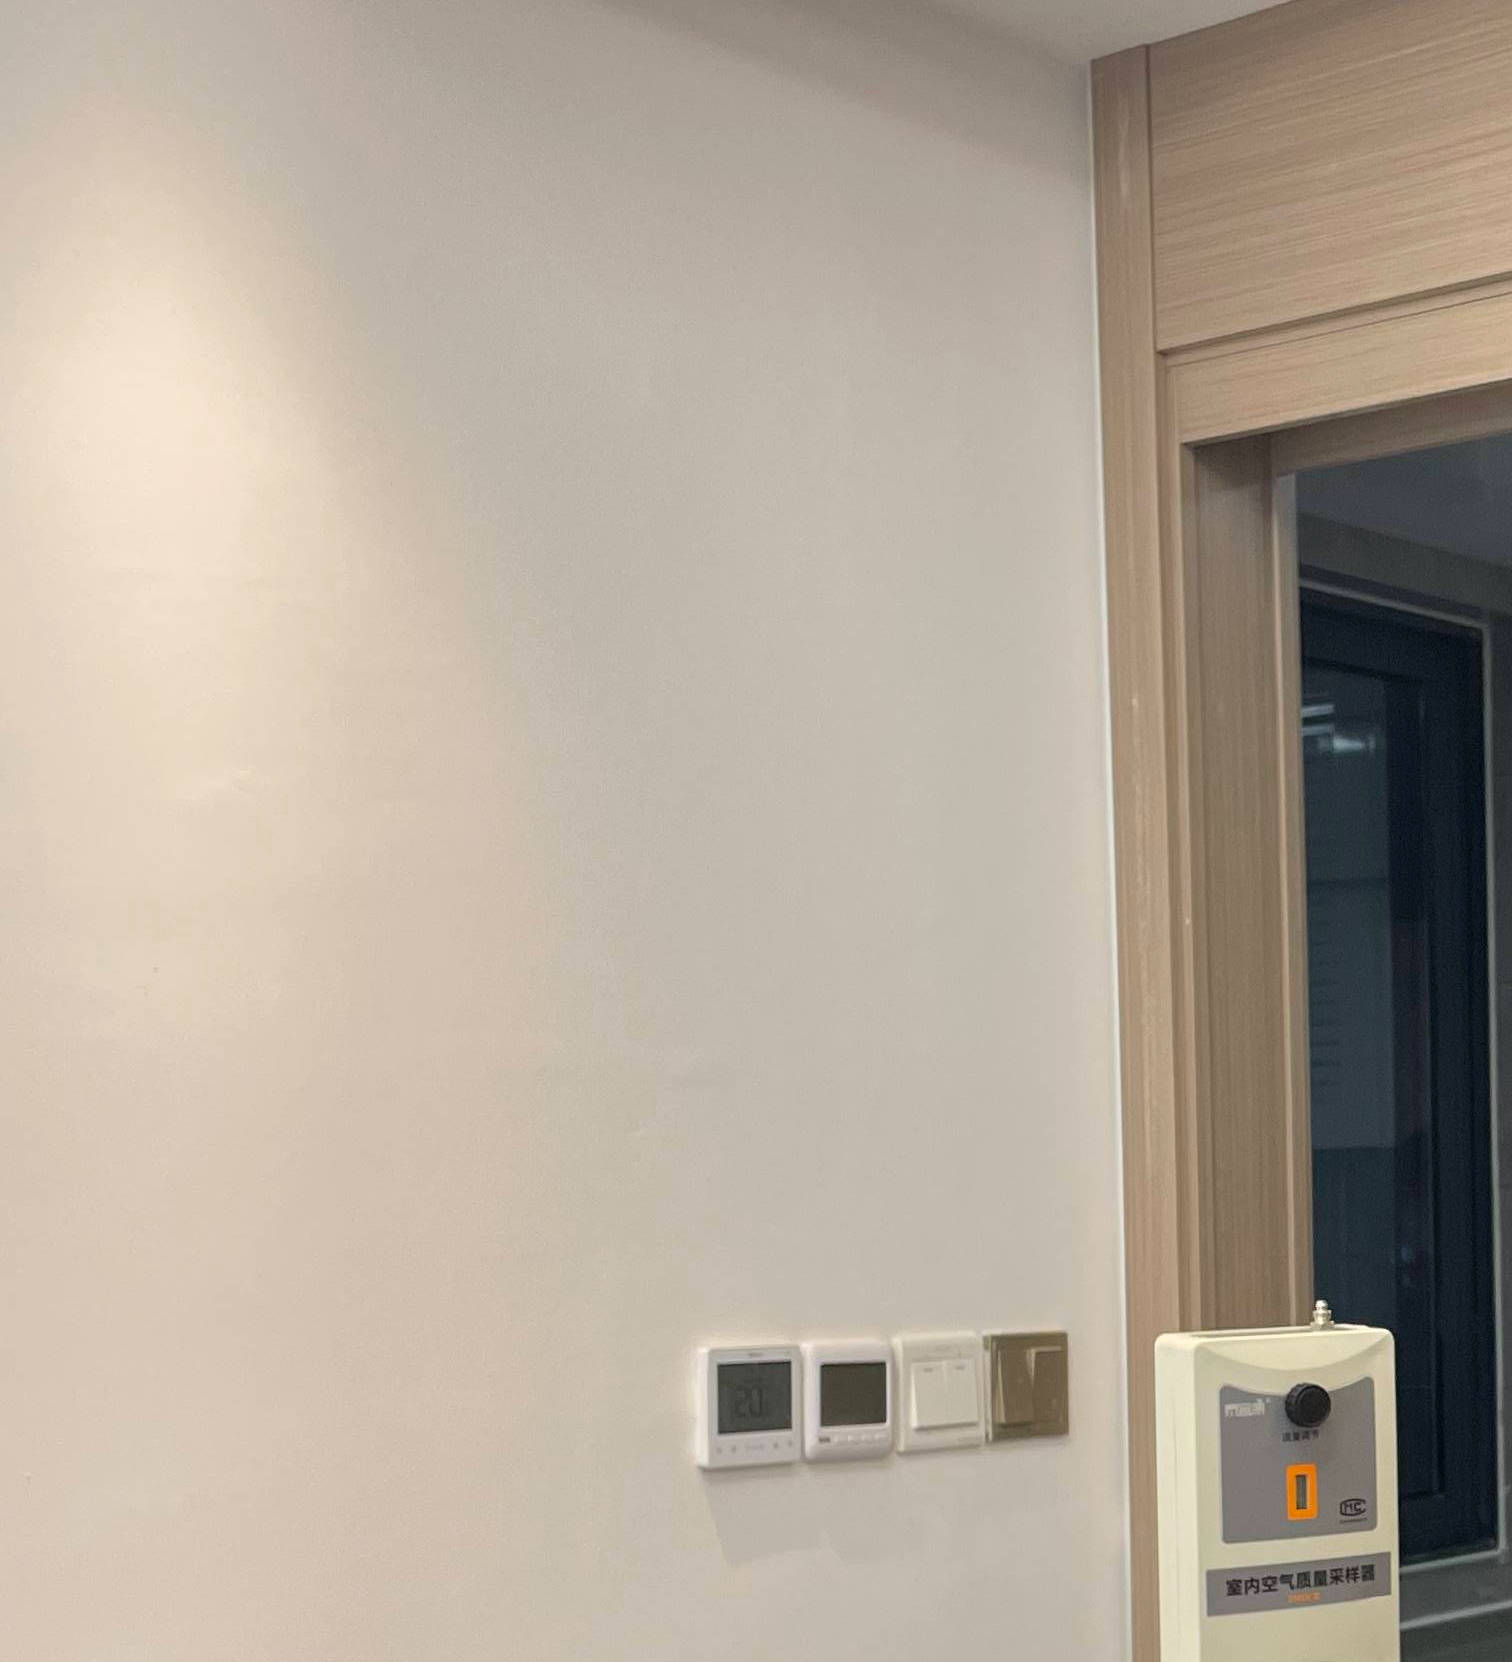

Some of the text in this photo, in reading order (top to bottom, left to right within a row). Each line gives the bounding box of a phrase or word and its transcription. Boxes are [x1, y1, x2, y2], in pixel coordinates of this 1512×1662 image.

[1226, 1564, 1376, 1596] 室内空气质量采样器
